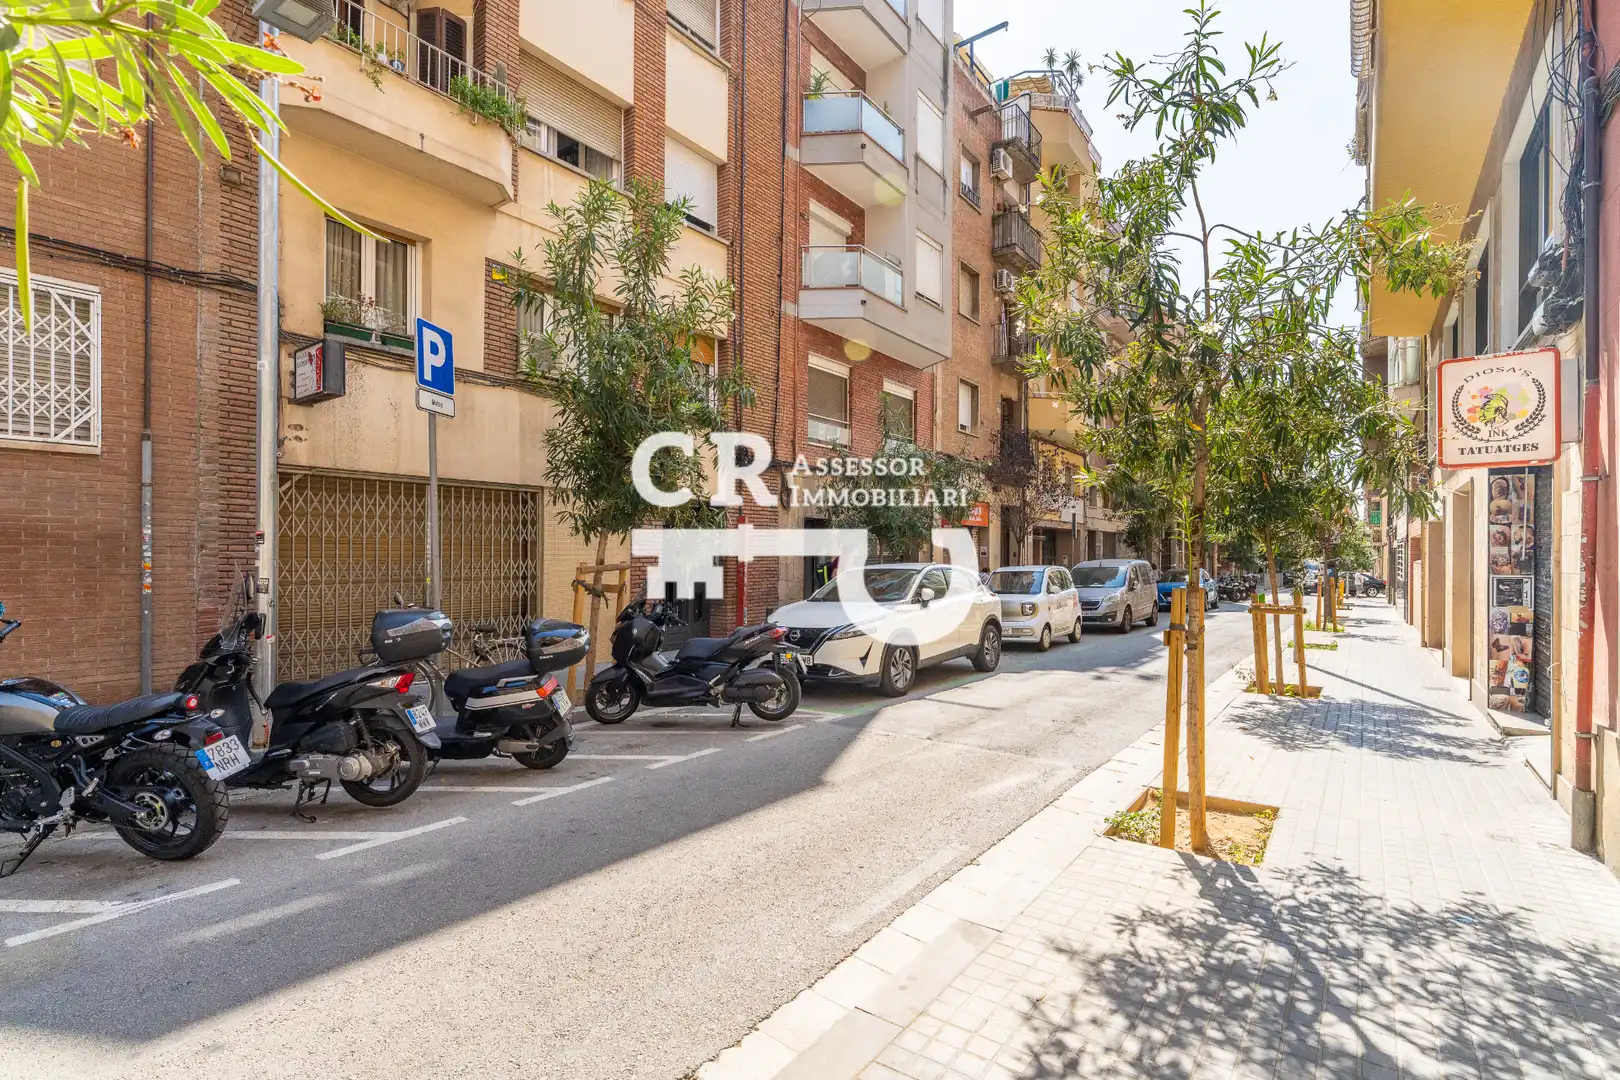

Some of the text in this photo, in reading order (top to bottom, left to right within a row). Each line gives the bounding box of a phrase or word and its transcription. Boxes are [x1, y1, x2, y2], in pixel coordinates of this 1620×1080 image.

[422, 326, 446, 382] P
[1463, 366, 1532, 383] DIOSA'S
[1488, 429, 1509, 438] INK
[1458, 442, 1539, 456] TATUATGES
[206, 738, 240, 761] 7833
[214, 753, 241, 773] NRH
